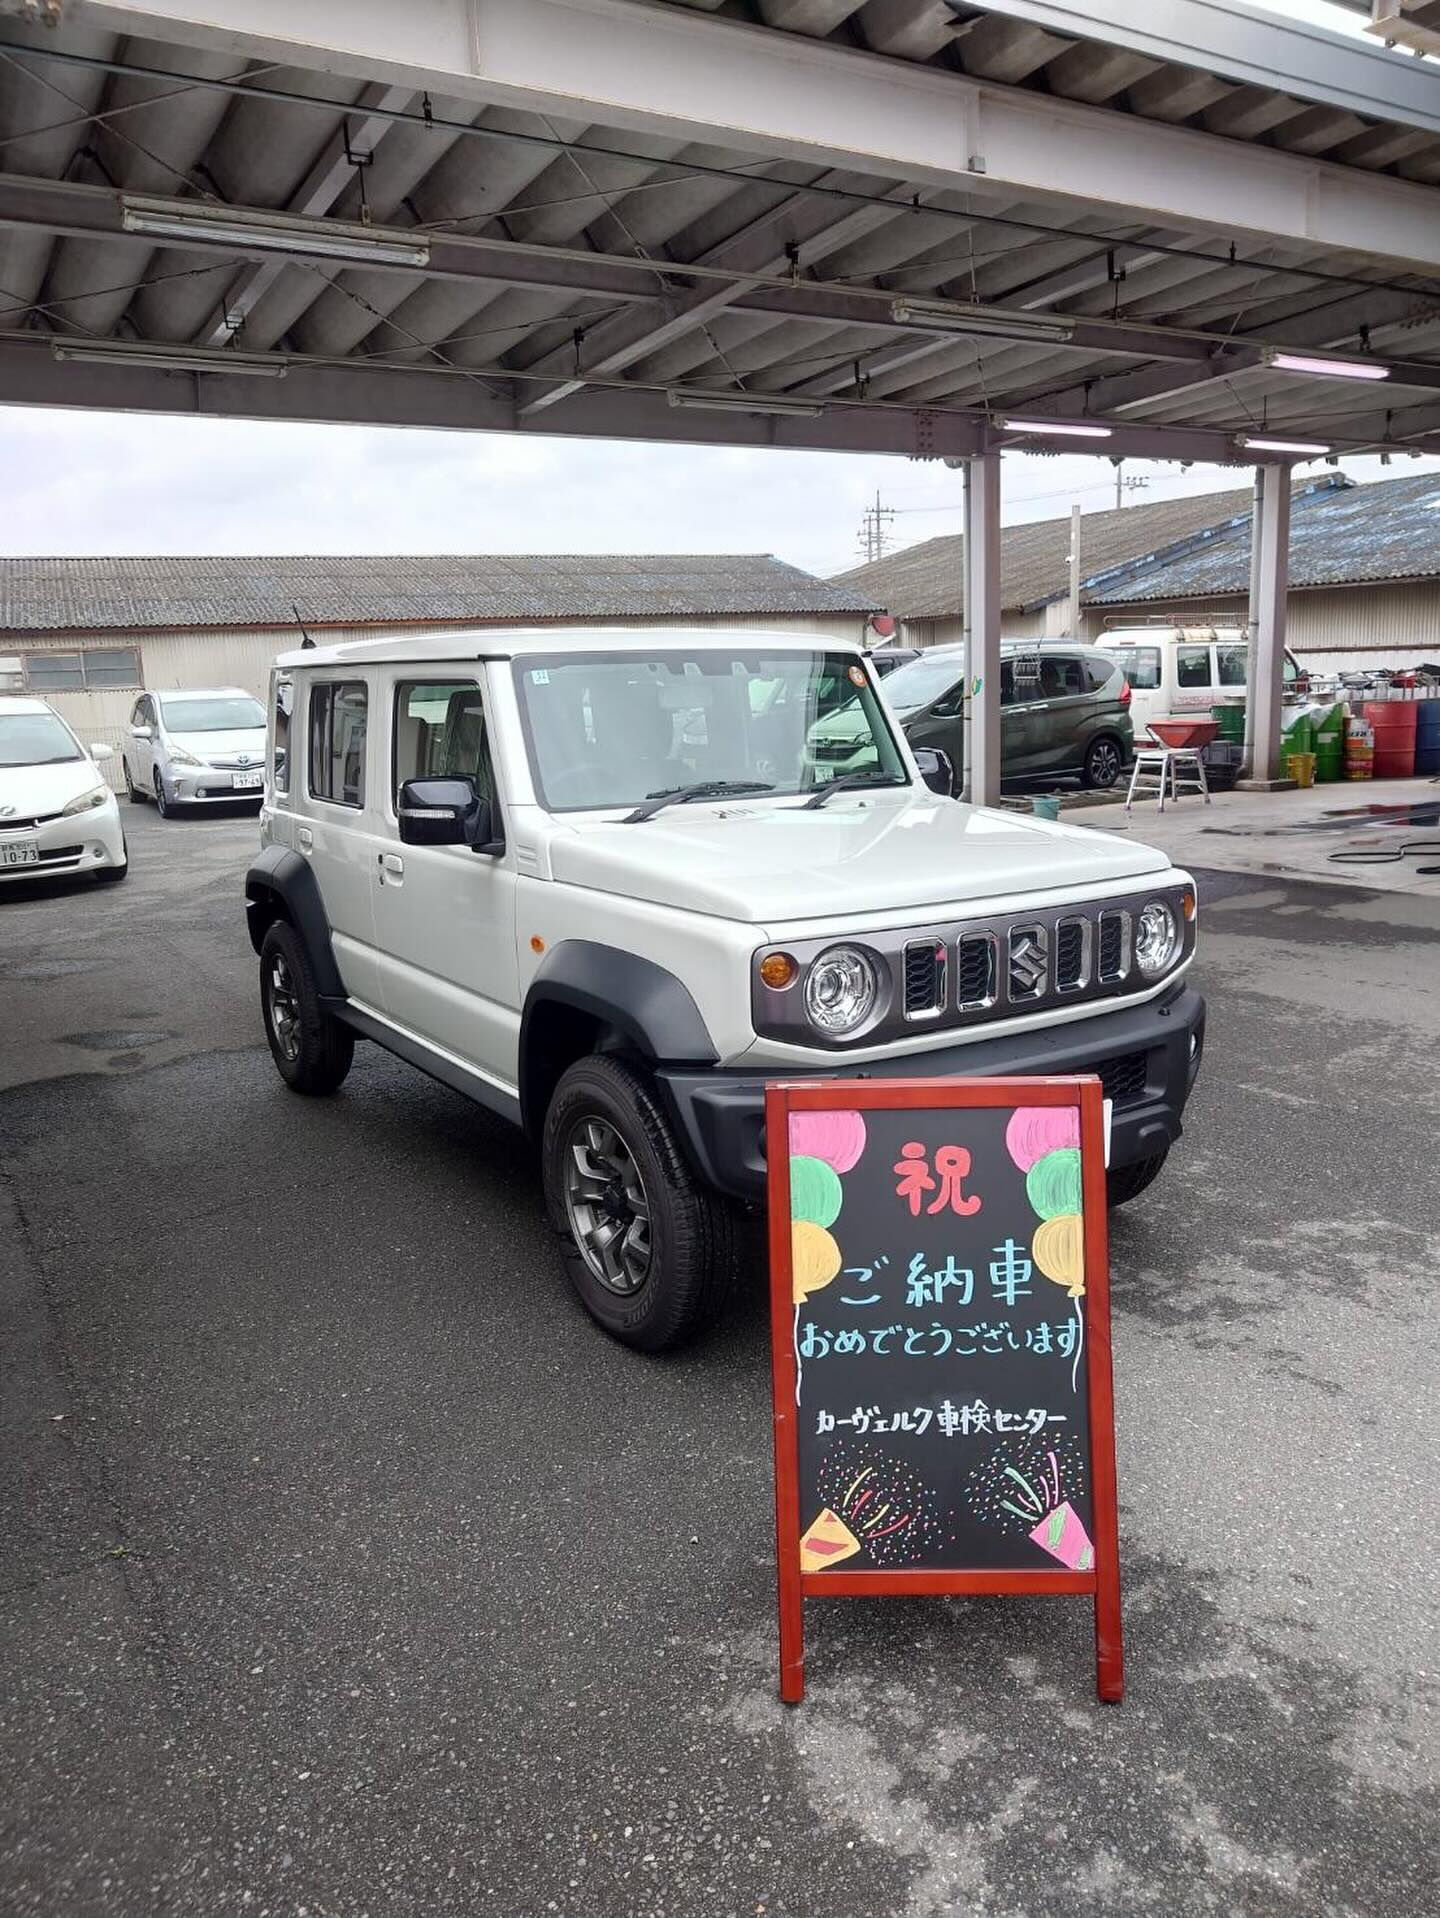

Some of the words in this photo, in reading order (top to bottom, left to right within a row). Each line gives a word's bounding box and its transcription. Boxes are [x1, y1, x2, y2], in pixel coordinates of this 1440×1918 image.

[3, 850, 37, 863] 10-73
[893, 1142, 982, 1216] 祝
[839, 1238, 1034, 1308] ご納車
[800, 1317, 1081, 1359] おめでとうございます
